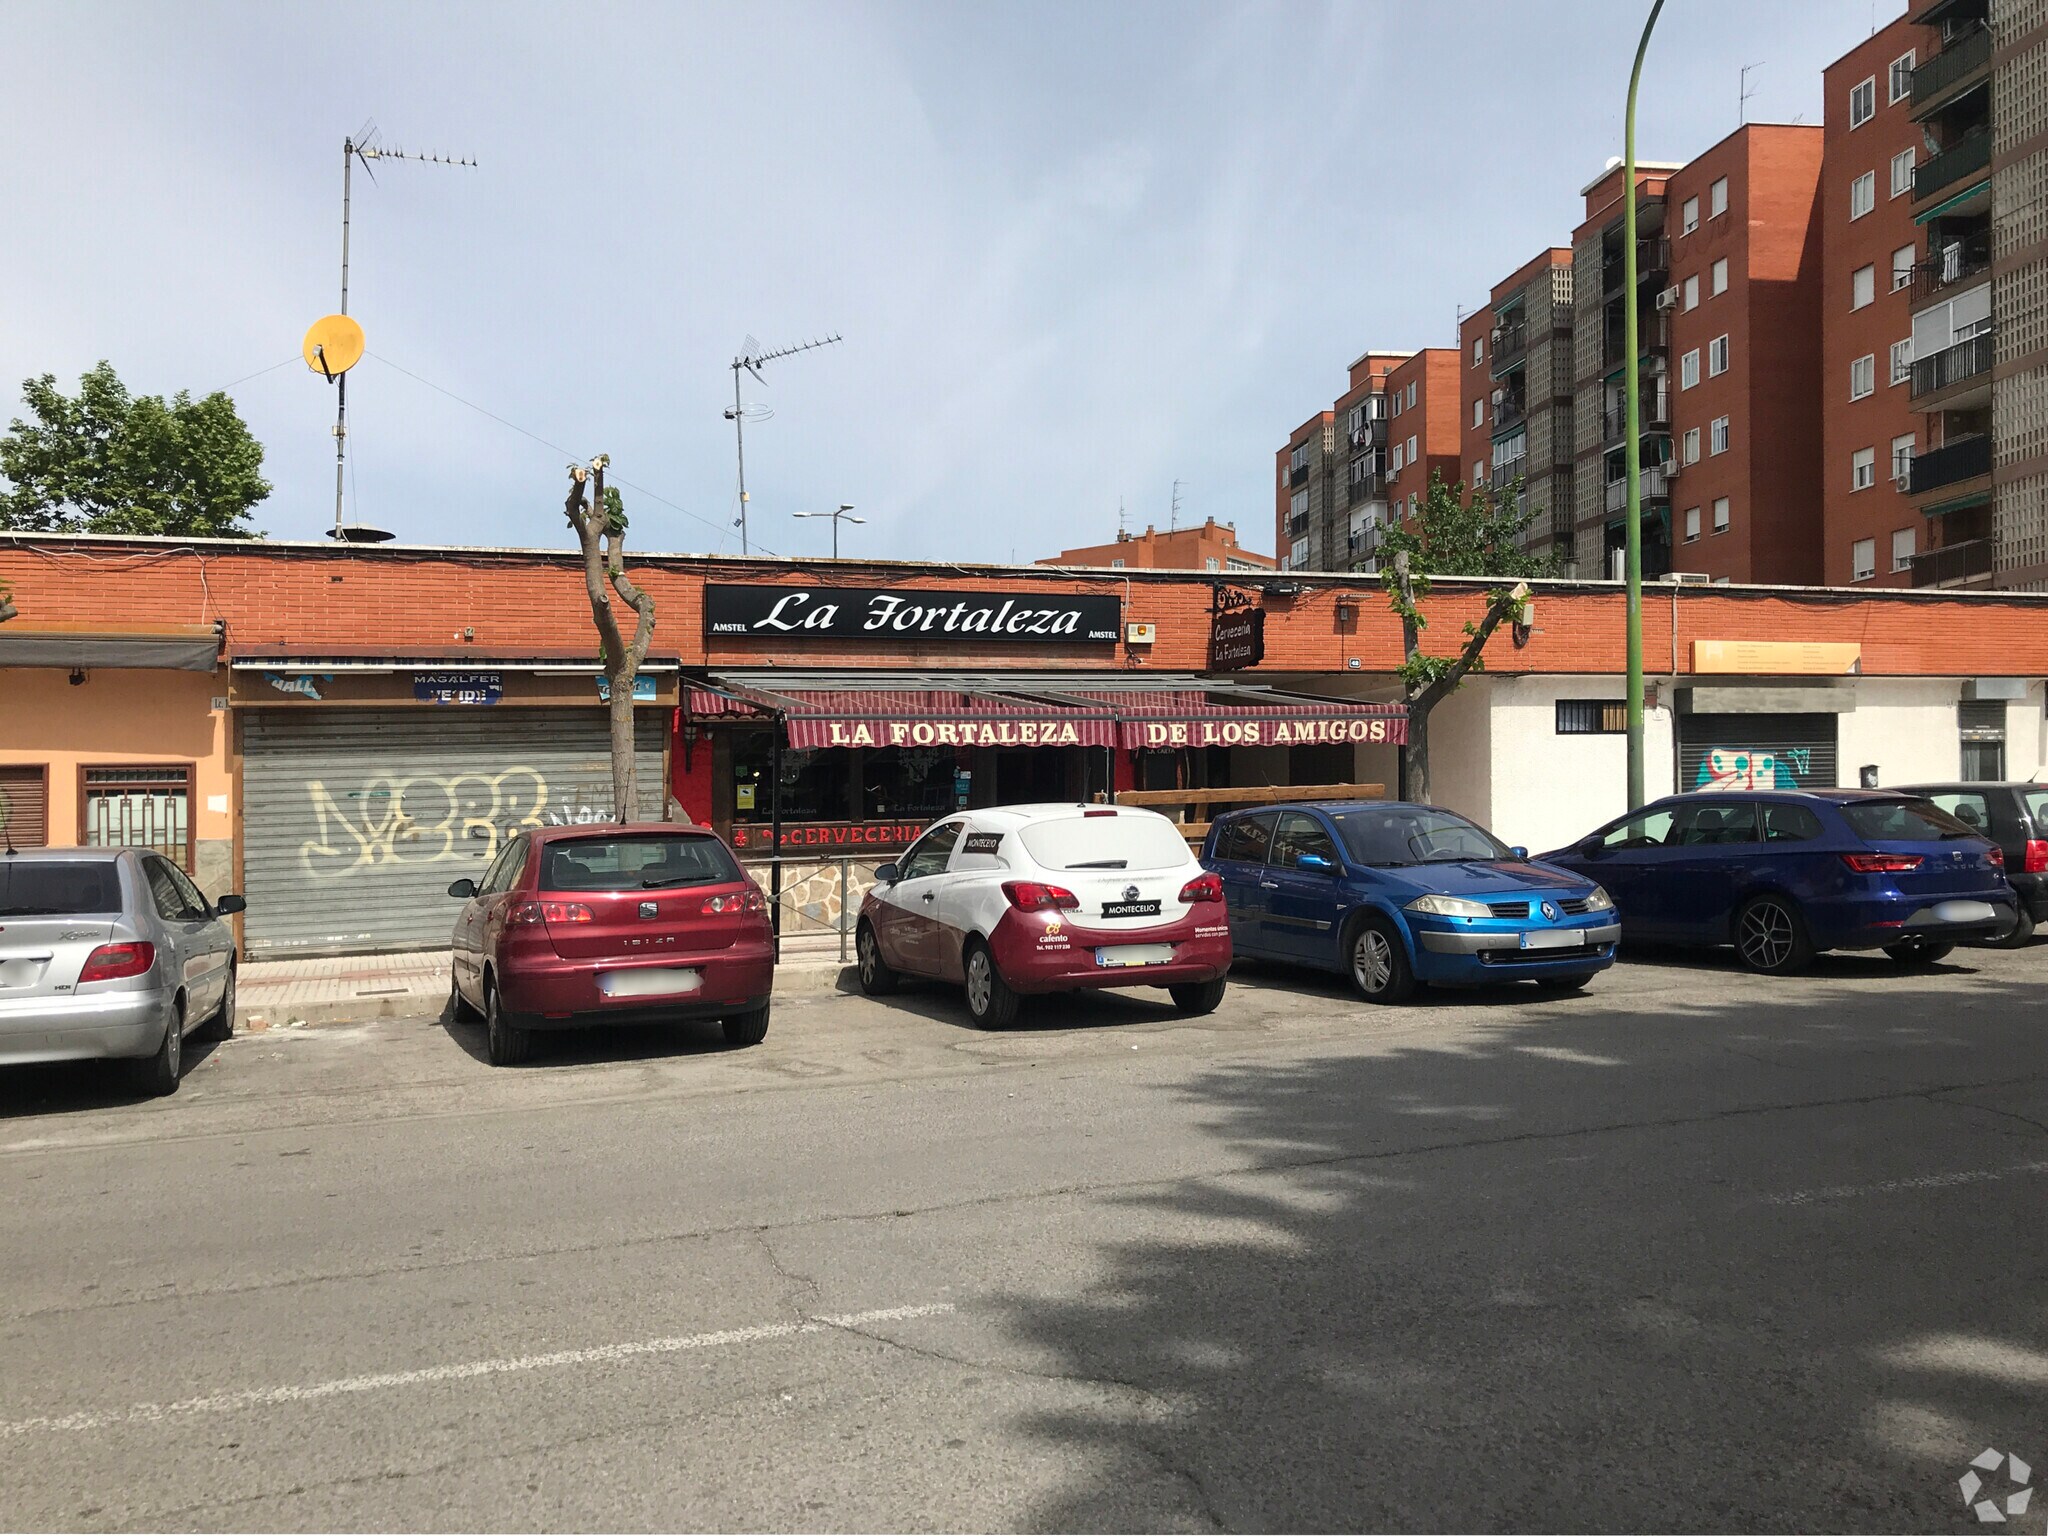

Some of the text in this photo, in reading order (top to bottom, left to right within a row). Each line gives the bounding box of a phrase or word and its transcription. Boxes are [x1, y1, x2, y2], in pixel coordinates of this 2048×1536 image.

[753, 592, 1082, 635] La Fortaleza
[713, 622, 747, 632] AMSTEL
[1088, 630, 1117, 639] AMSTEL
[1216, 643, 1251, 660] La Fortaleza
[414, 675, 500, 683] MAGALFER
[830, 720, 1386, 744] LA FORTALEZA DE LOS AMIGOS
[791, 825, 924, 844] CERVECERIA
[1109, 904, 1155, 914] MONTECELIO
[1039, 934, 1068, 943] cafento
